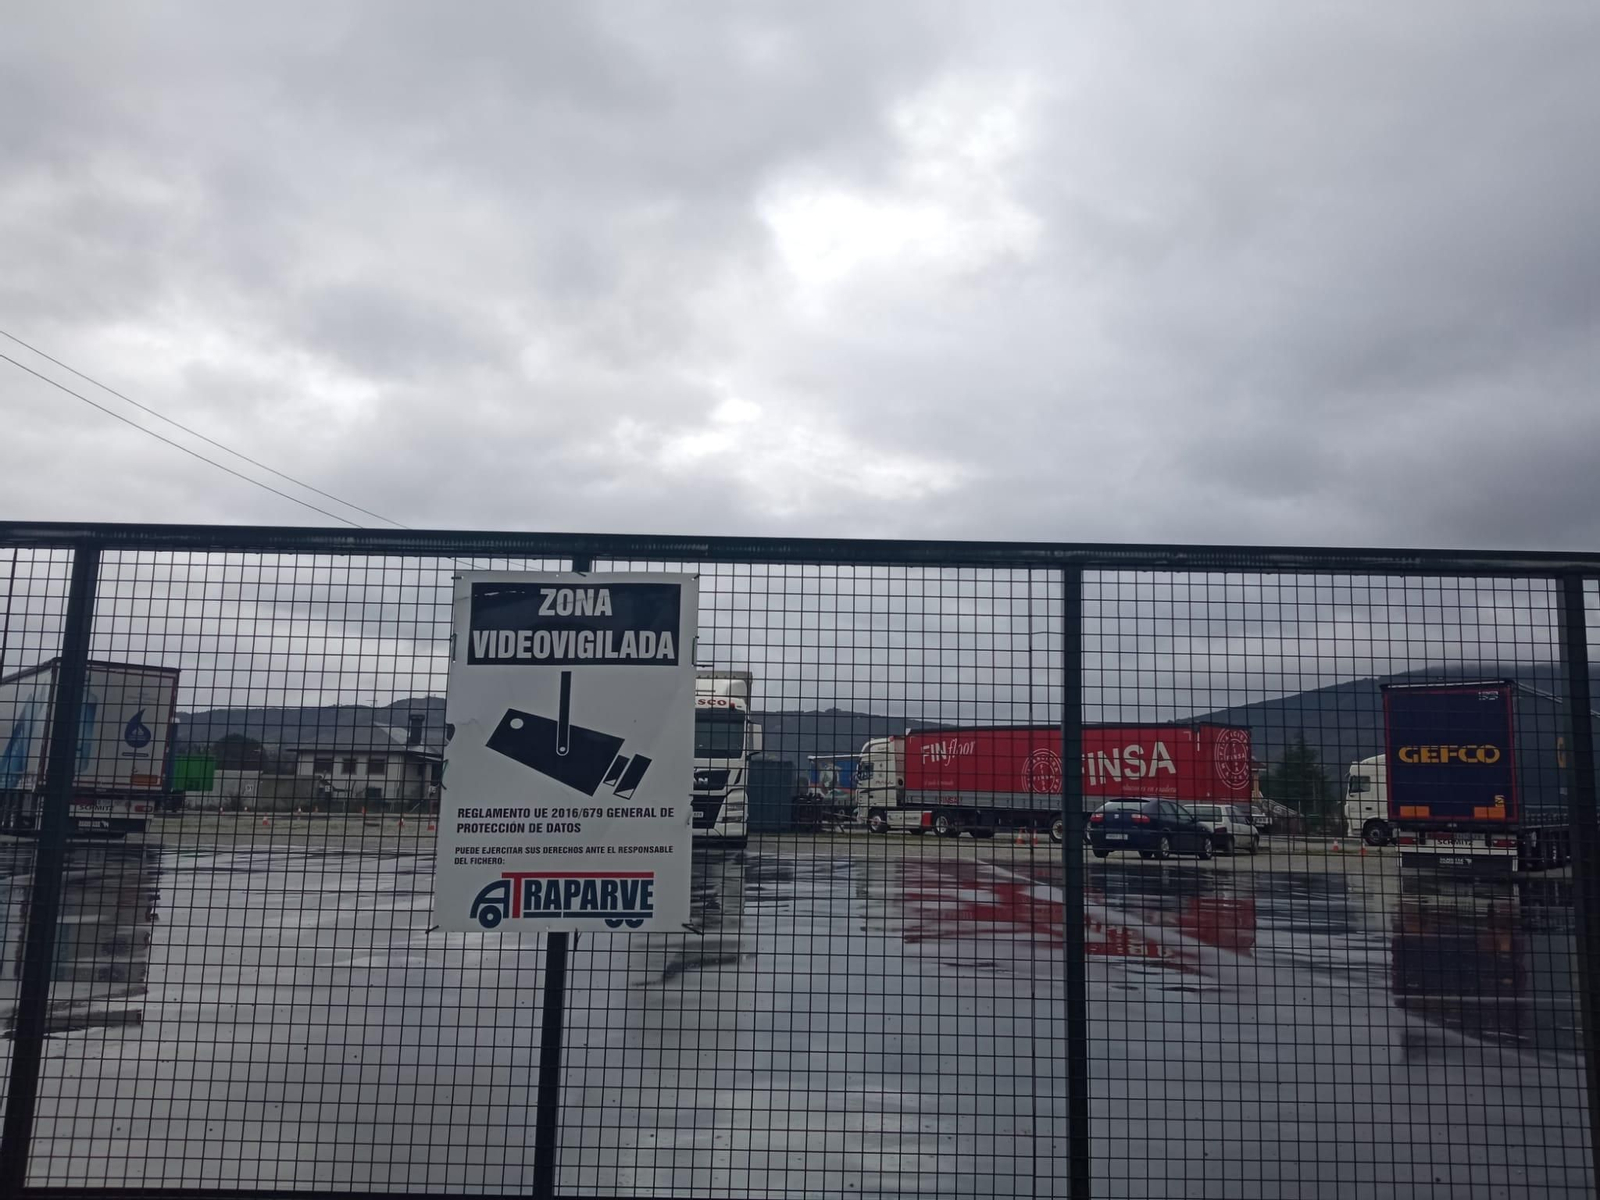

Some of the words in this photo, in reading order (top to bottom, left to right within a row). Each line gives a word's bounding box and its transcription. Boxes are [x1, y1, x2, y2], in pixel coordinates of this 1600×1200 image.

[538, 588, 613, 617] ZONA
[473, 630, 675, 660] VIDEOVIGILADA
[1081, 741, 1177, 786] INSA
[1398, 745, 1501, 764] GEFCO
[458, 808, 530, 819] REGLAMENTO
[534, 808, 548, 819] UE
[551, 807, 603, 819] 2016/679
[606, 807, 657, 818] GENERAL
[660, 807, 675, 818] DE
[456, 820, 525, 834] PROTECCIÓN
[529, 823, 543, 833] DE
[546, 823, 581, 833] DATOS
[455, 846, 480, 854] PUEDE
[482, 846, 523, 855] EJERCITAR
[525, 846, 541, 854] SUS
[543, 846, 583, 854] DERECHOS
[586, 846, 605, 854] ANTE
[607, 846, 616, 854] EL
[618, 846, 674, 854] RESPONSABLE
[454, 857, 468, 865] DEL
[470, 857, 505, 865] FICHERO:
[502, 871, 655, 919] TRAPARVE
